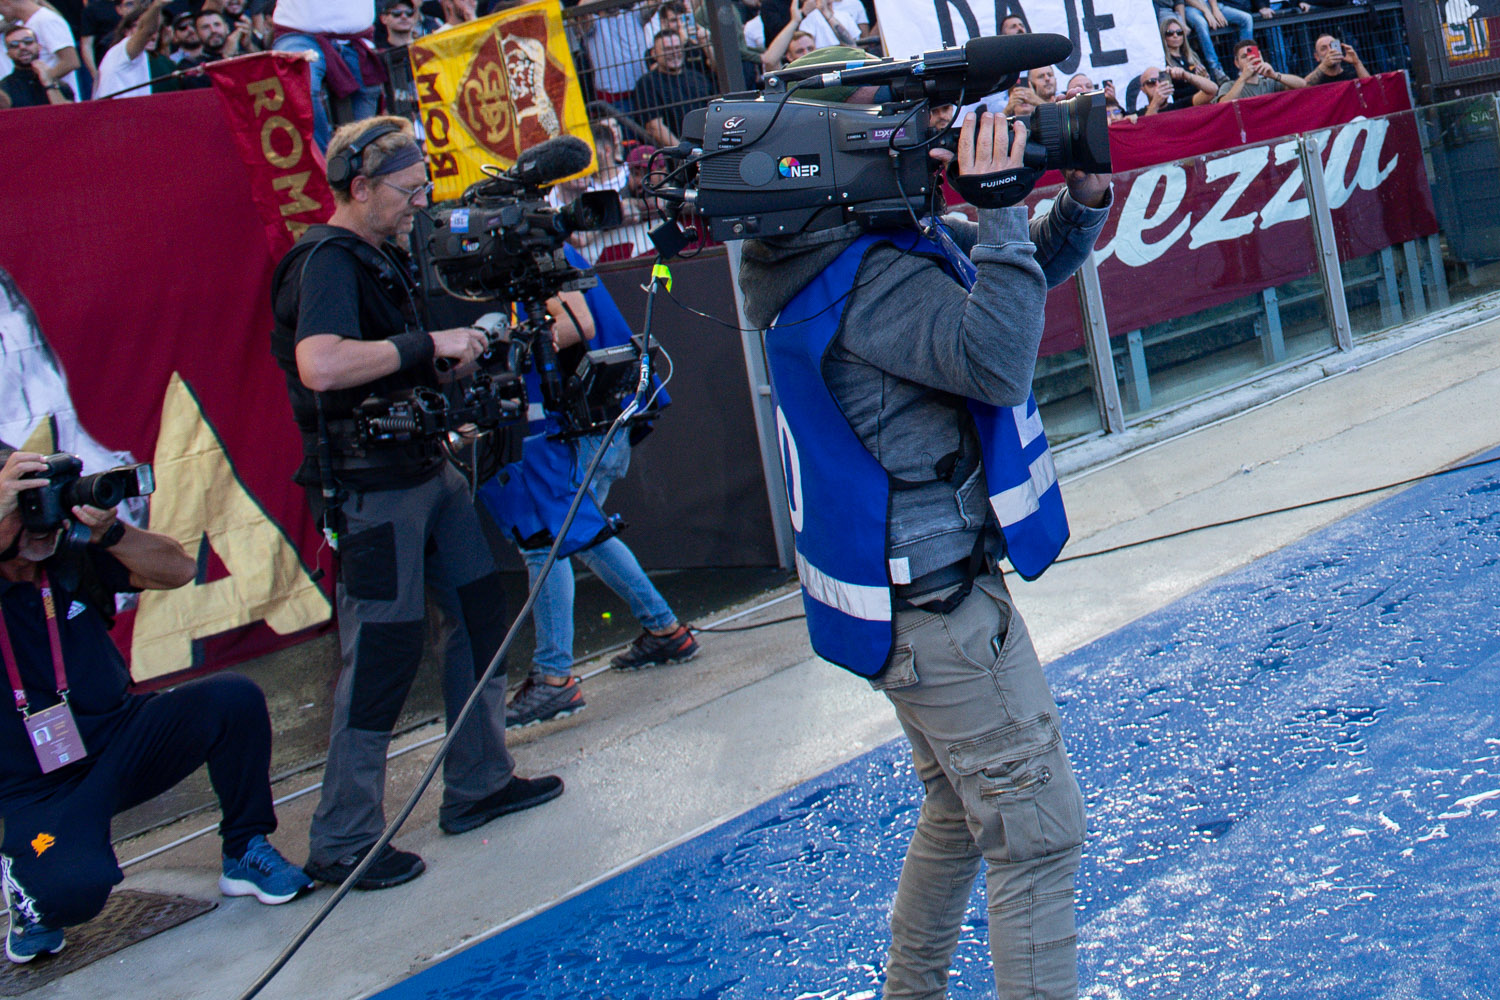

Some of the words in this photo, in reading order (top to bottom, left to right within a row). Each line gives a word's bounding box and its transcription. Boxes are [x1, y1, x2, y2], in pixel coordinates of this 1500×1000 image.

[790, 163, 820, 178] NEP
[980, 174, 1018, 190] FUJINON
[1094, 115, 1400, 268] ezza
